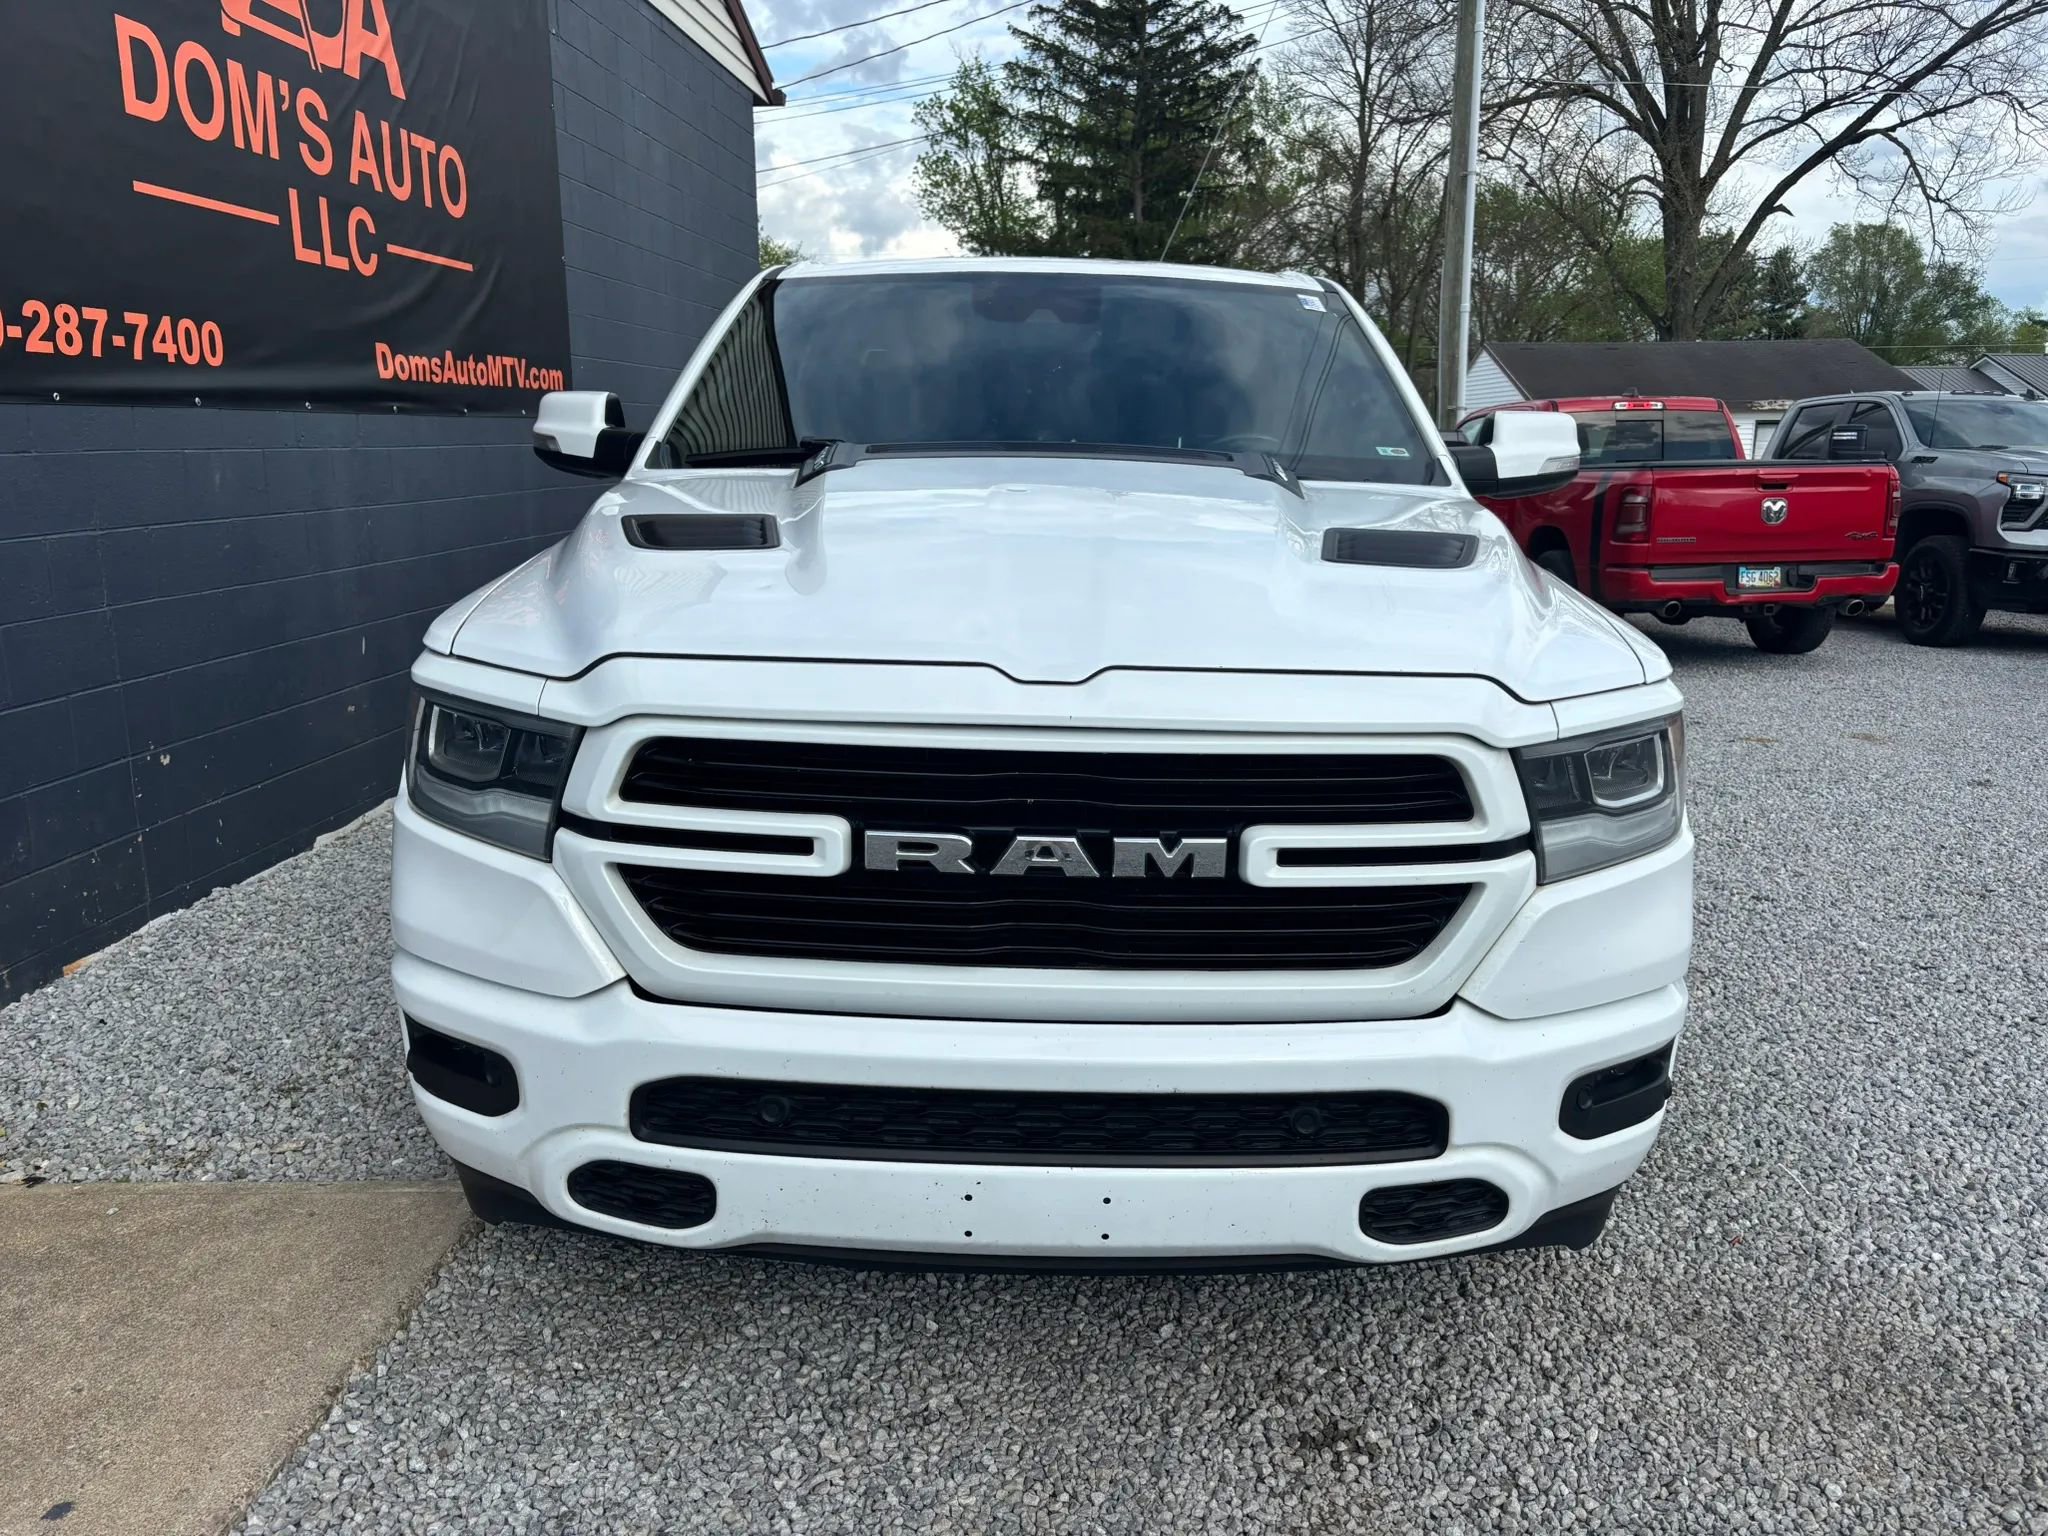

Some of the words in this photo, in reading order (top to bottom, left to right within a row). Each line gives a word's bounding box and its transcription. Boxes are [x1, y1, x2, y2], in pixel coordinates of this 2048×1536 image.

[114, 14, 333, 176] DOM'S
[349, 110, 468, 219] AUTO
[287, 188, 378, 277] LLC
[0, 299, 224, 368] -287-7400
[375, 341, 565, 392] DomsAutoMTV.com
[864, 830, 1229, 878] RAM
